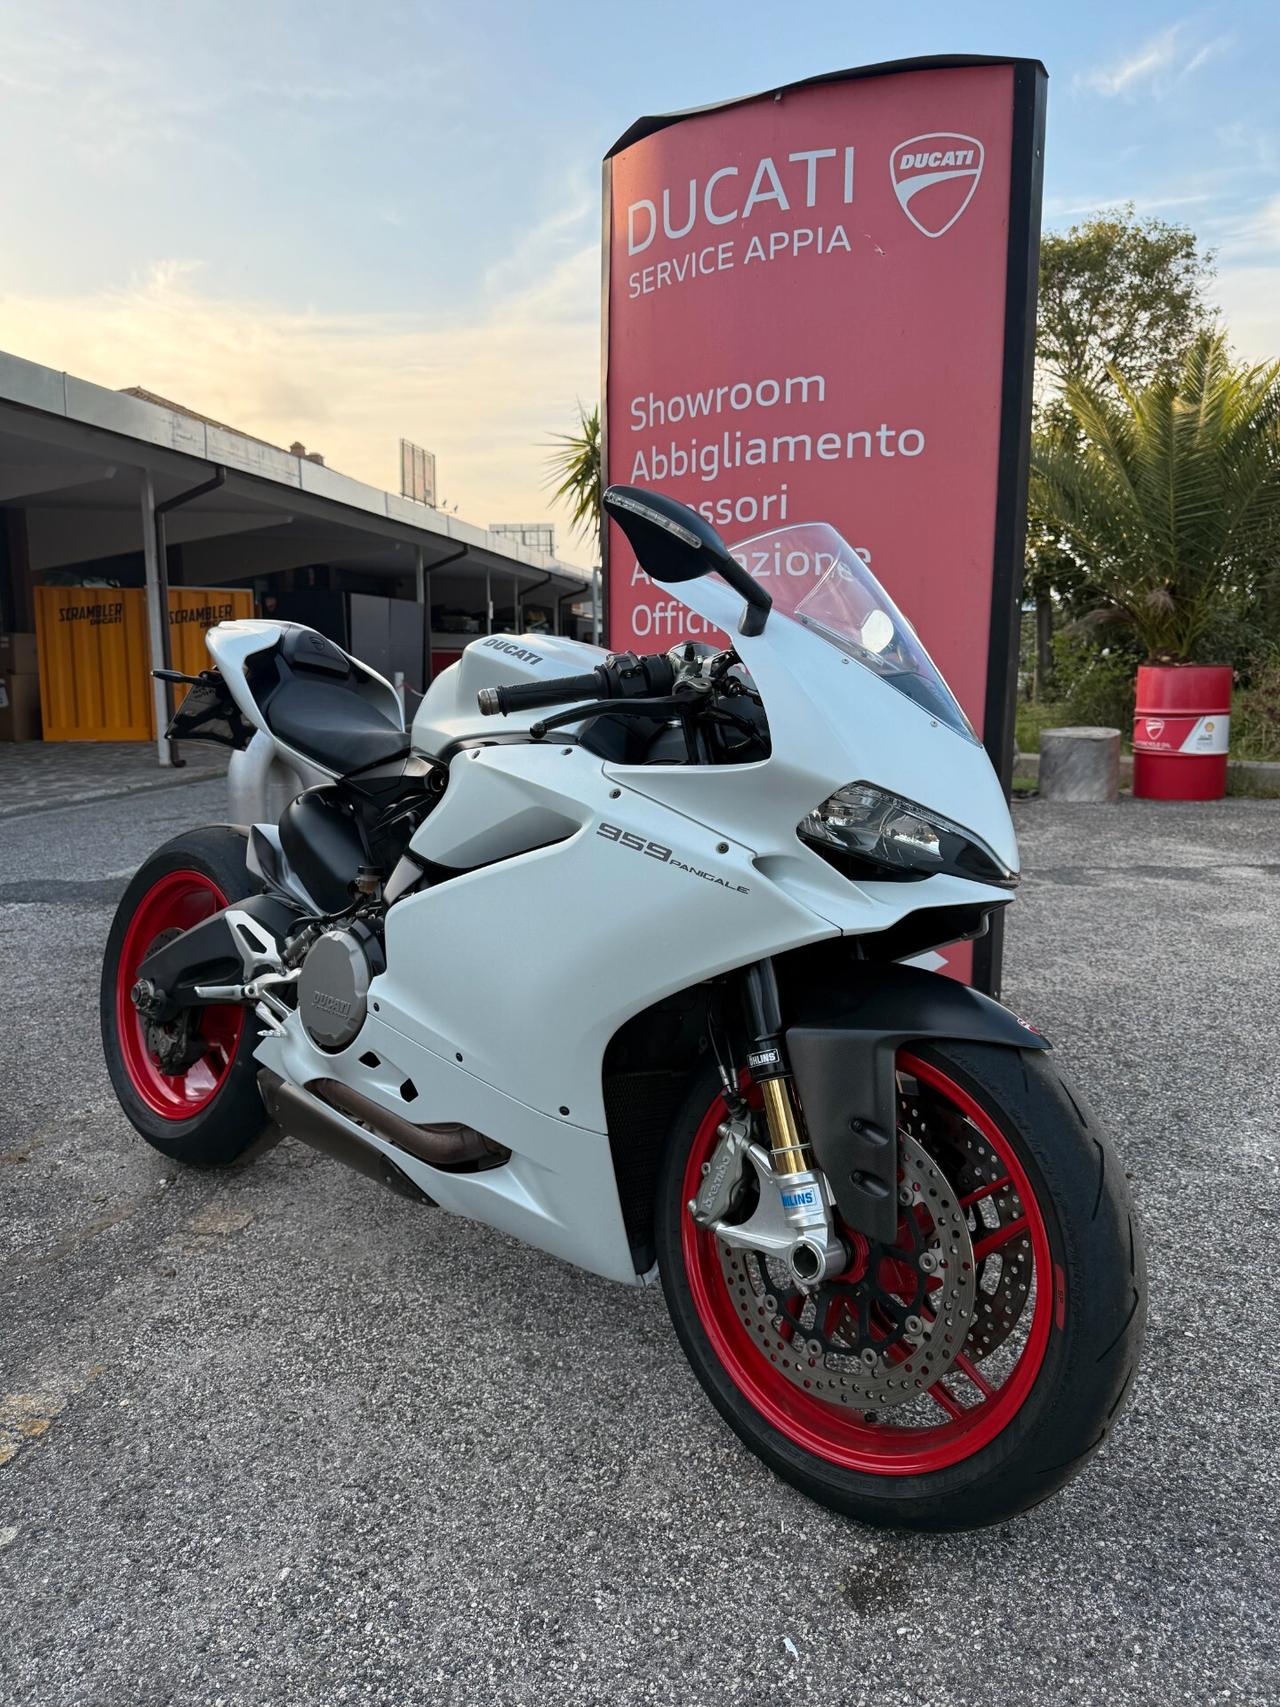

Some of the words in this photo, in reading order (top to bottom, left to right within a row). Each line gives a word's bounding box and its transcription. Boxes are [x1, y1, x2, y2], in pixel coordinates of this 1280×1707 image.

[899, 150, 975, 170] DUCATI
[627, 146, 855, 257] DUCATI
[628, 241, 735, 299] SERVICE
[743, 225, 852, 265] APPIA
[630, 373, 826, 432] Showroom
[630, 423, 926, 482] Abbigliamento
[686, 483, 788, 525] ssori
[59, 603, 122, 622] SCRAMBLER
[482, 638, 544, 666] DUCATI
[596, 822, 673, 863] 959
[669, 858, 751, 895] PANIGALE
[313, 990, 351, 1014] DUCATI
